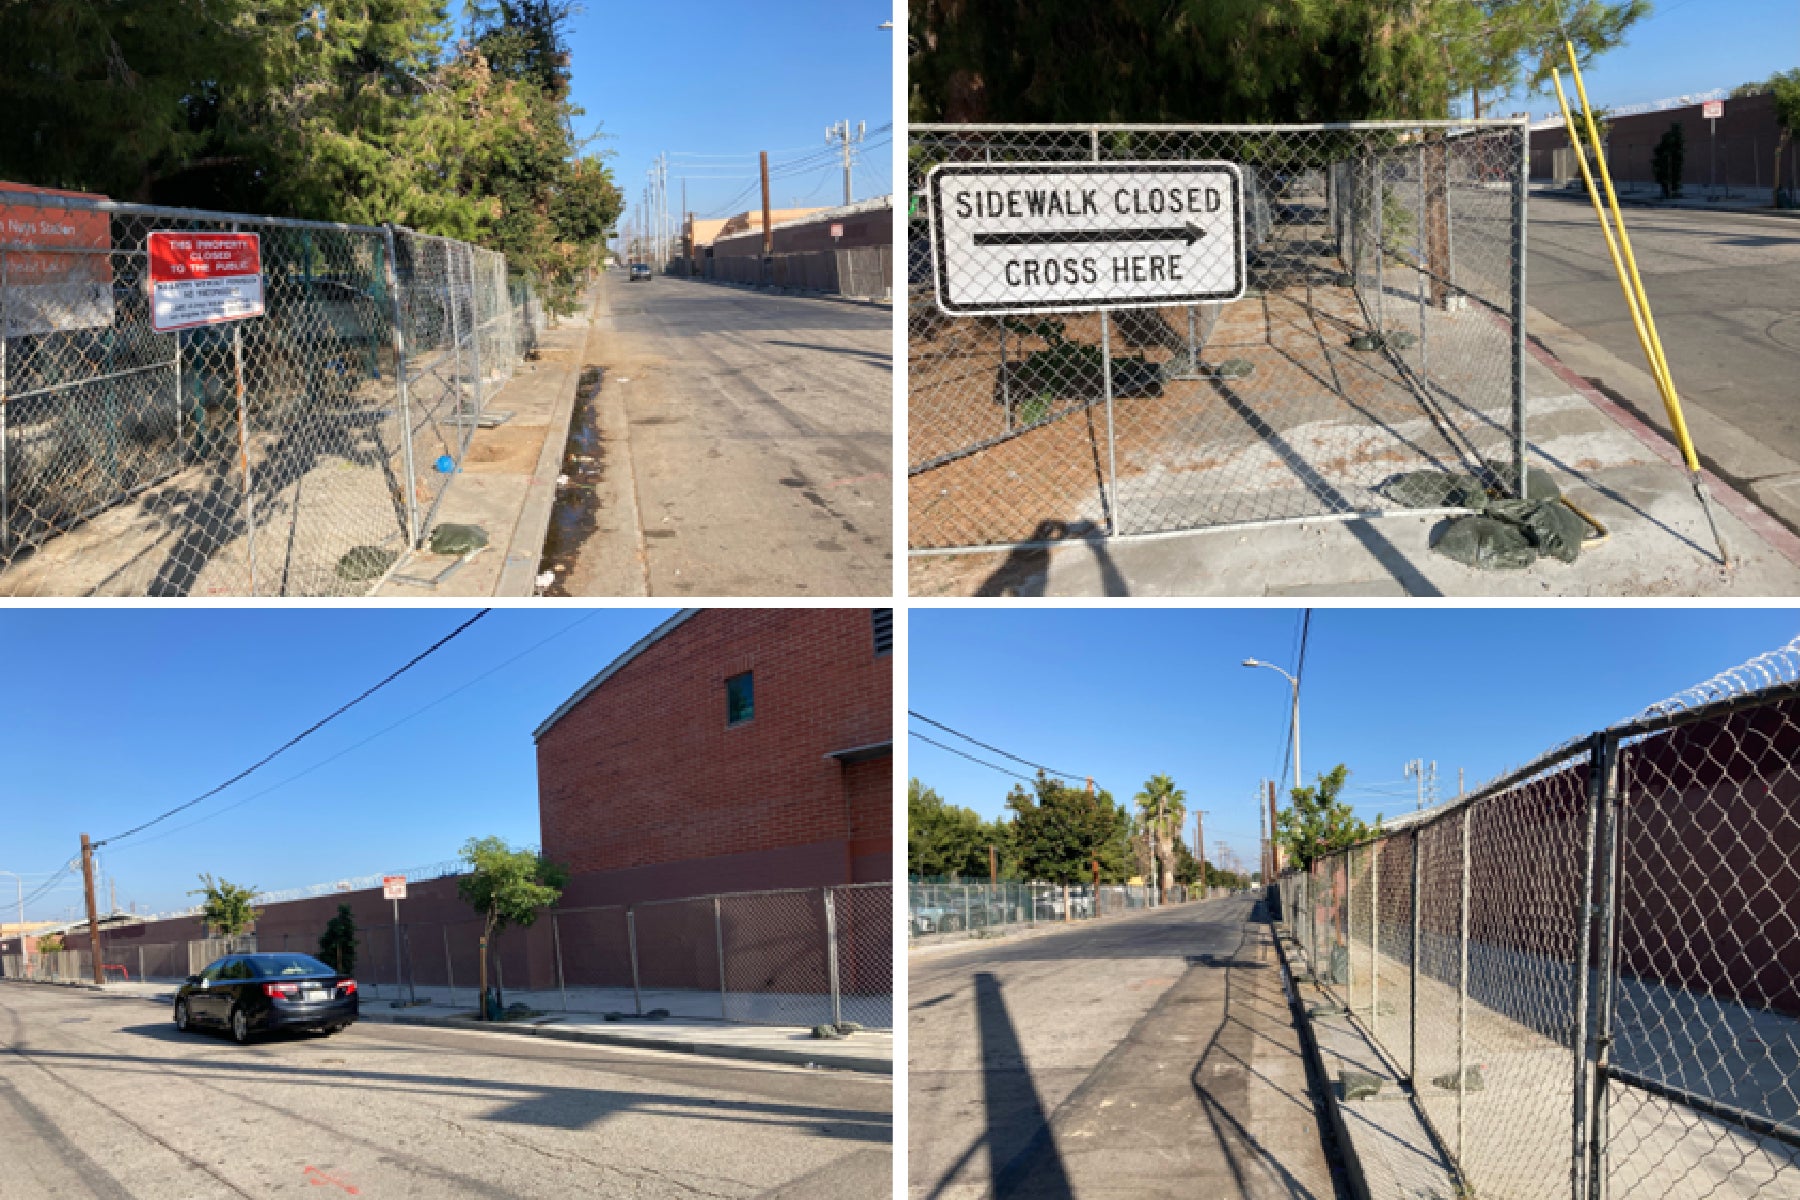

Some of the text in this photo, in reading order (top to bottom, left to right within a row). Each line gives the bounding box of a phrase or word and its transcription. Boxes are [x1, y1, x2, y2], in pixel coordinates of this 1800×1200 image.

[956, 187, 1221, 219] SIDEWALK CLOSED
[169, 240, 248, 250] THIS PROPERTY
[189, 251, 231, 261] CLOSED
[170, 260, 249, 274] TO THE PUBLIC
[1005, 254, 1184, 286] CROSS HERE
